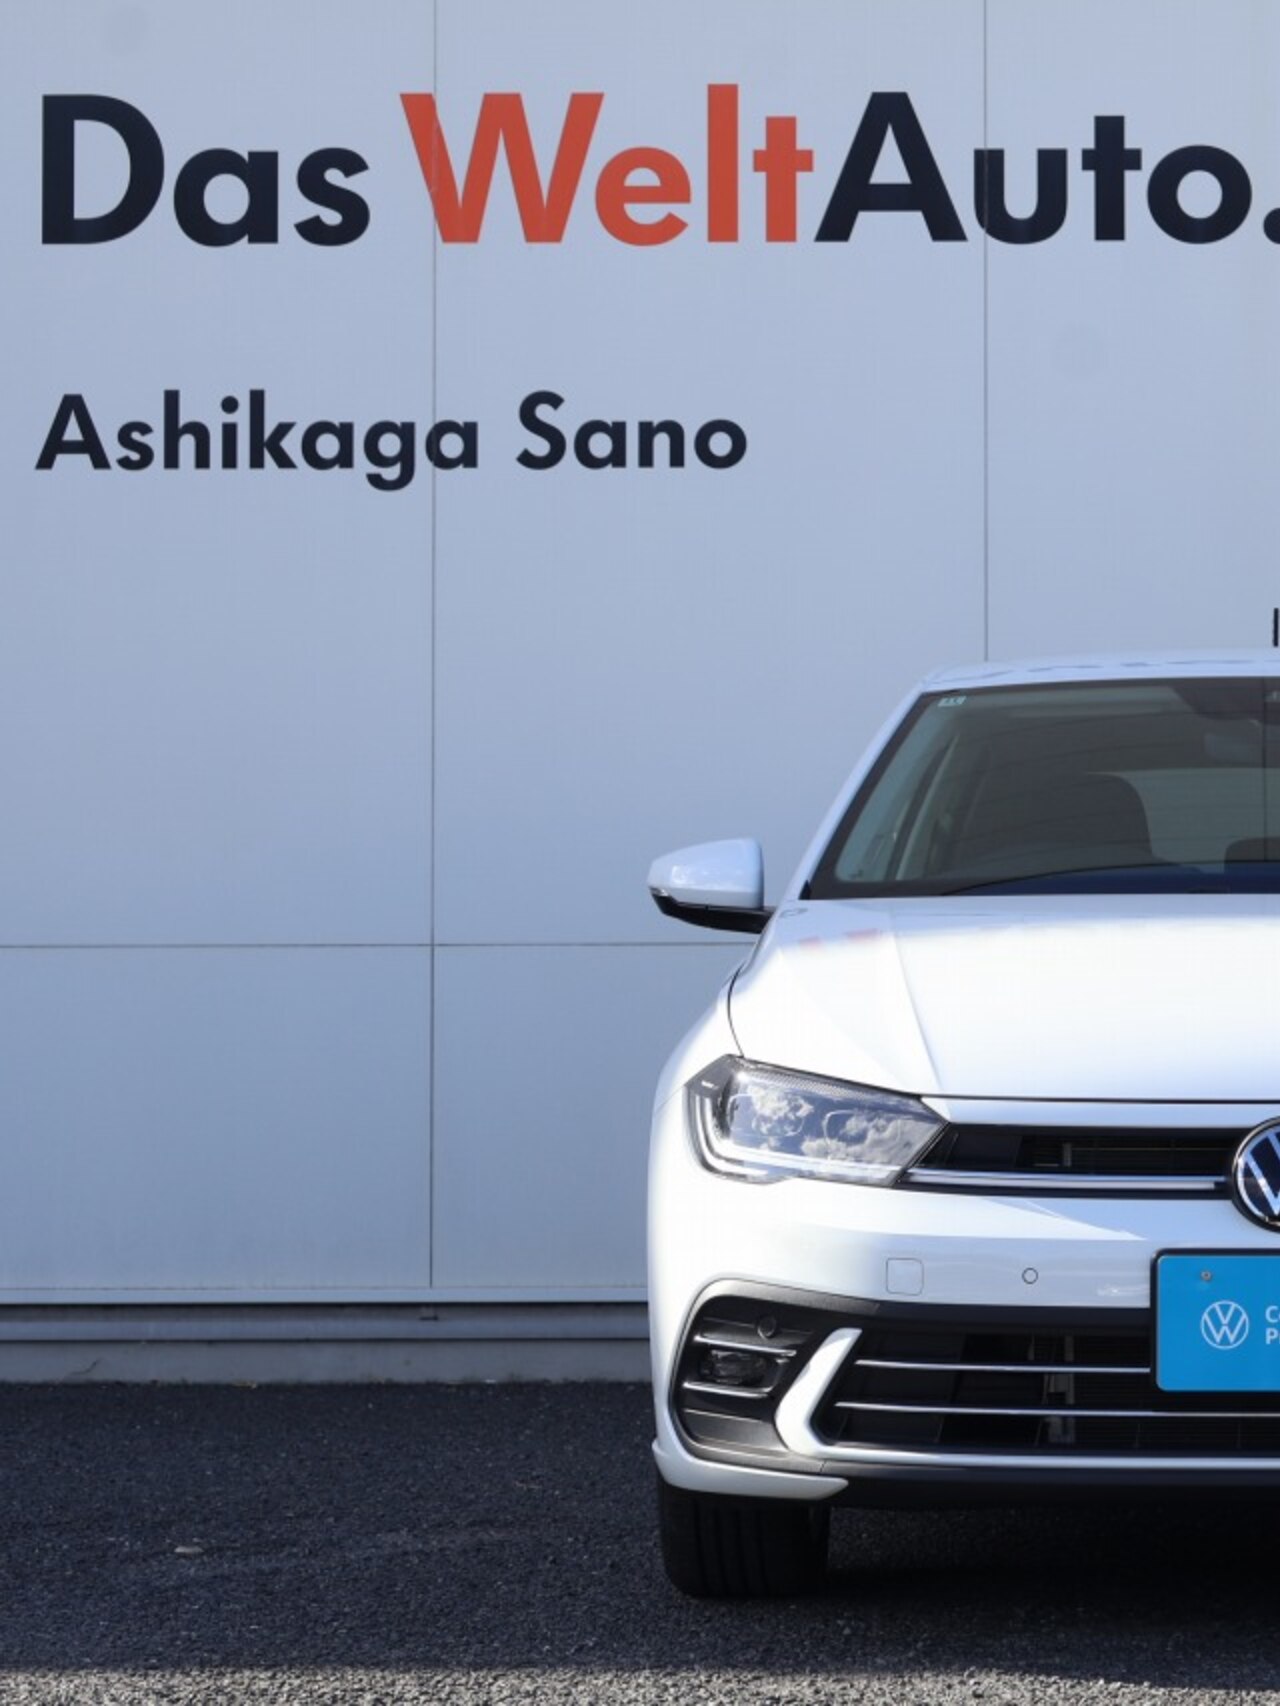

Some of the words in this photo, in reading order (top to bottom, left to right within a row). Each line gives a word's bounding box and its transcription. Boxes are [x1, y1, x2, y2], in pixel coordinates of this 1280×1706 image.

[41, 94, 370, 247] Das
[35, 389, 478, 491] Ashikaga
[516, 391, 747, 470] Sano
